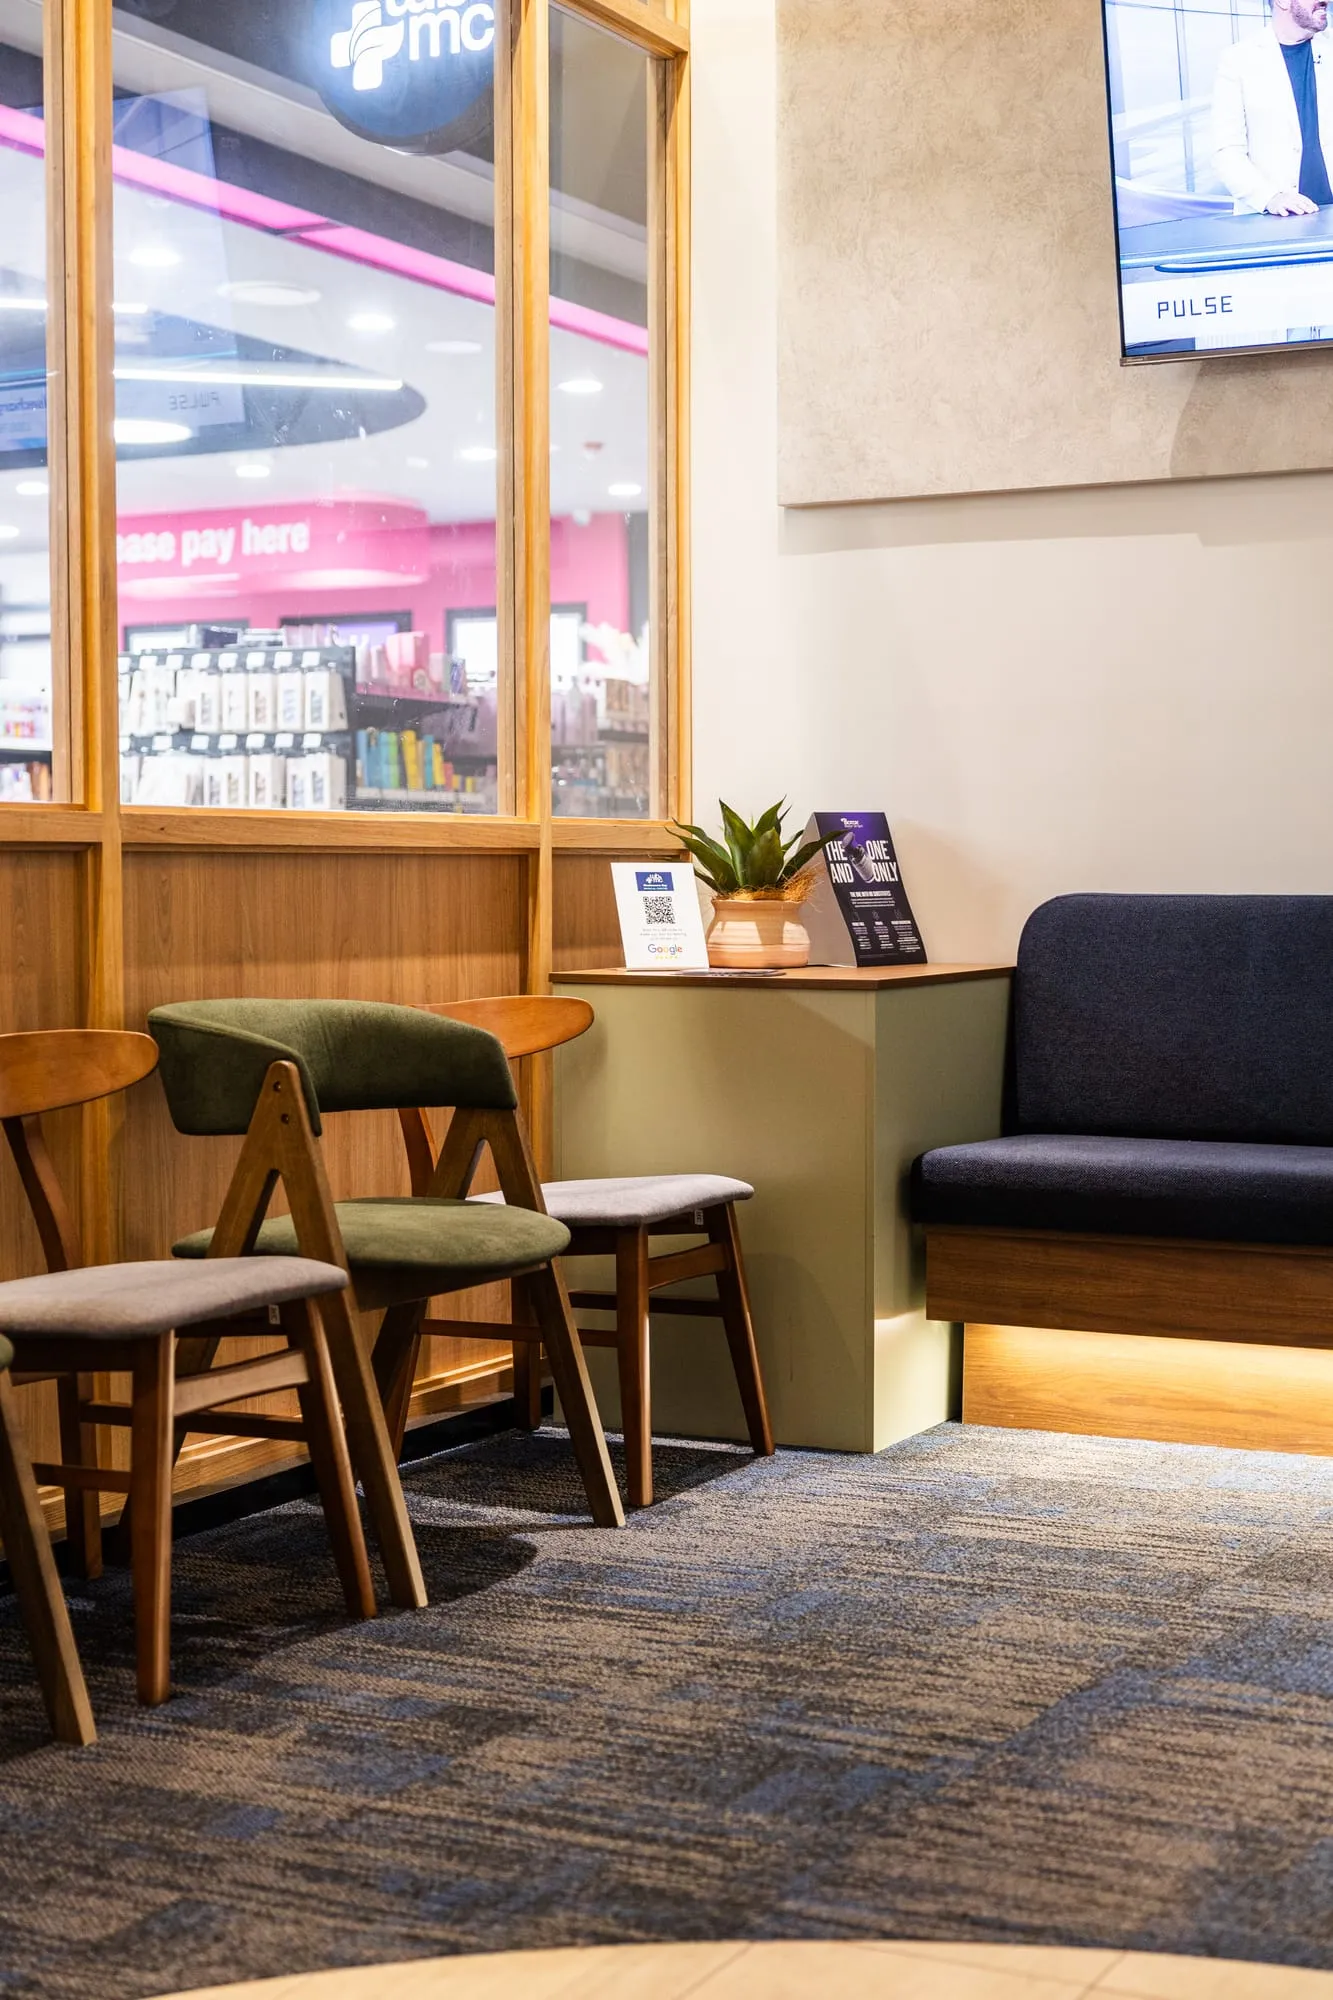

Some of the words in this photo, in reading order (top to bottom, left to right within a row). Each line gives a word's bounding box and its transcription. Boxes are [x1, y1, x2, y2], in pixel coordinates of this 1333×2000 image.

[409, 3, 494, 61] mc
[1157, 295, 1233, 319] PULSE
[181, 528, 236, 567] pay
[242, 518, 310, 555] here
[825, 840, 848, 861] THE
[866, 840, 890, 860] ONE
[831, 863, 854, 883] AND
[872, 862, 899, 882] ONLY
[647, 943, 683, 956] Google
